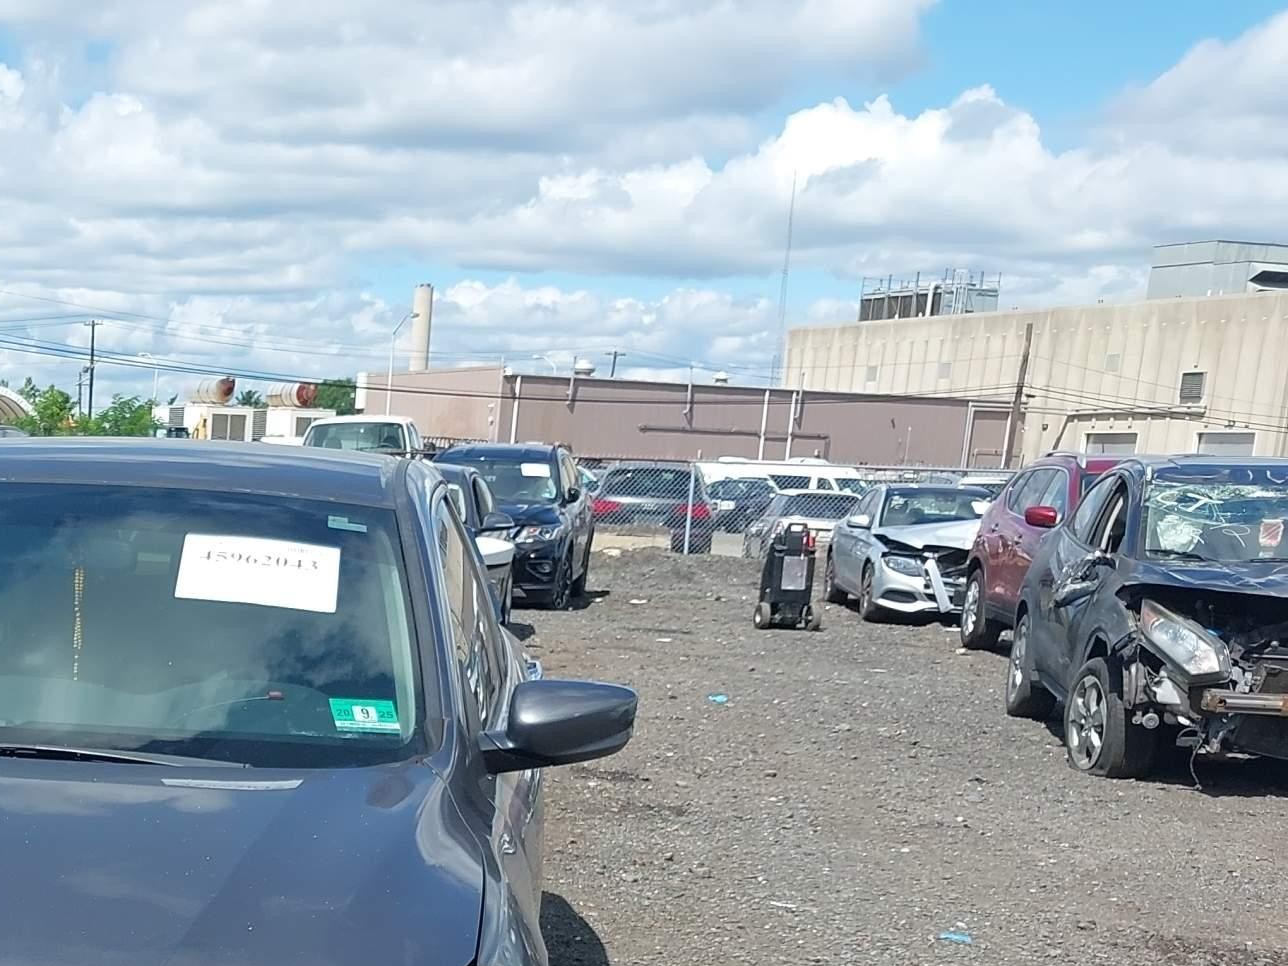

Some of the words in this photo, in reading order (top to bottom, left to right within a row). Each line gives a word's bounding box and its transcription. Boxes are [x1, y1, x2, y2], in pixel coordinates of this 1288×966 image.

[199, 550, 319, 570] 45962043
[335, 708, 350, 718] 20
[360, 707, 370, 720] 9
[378, 711, 394, 719] 25
